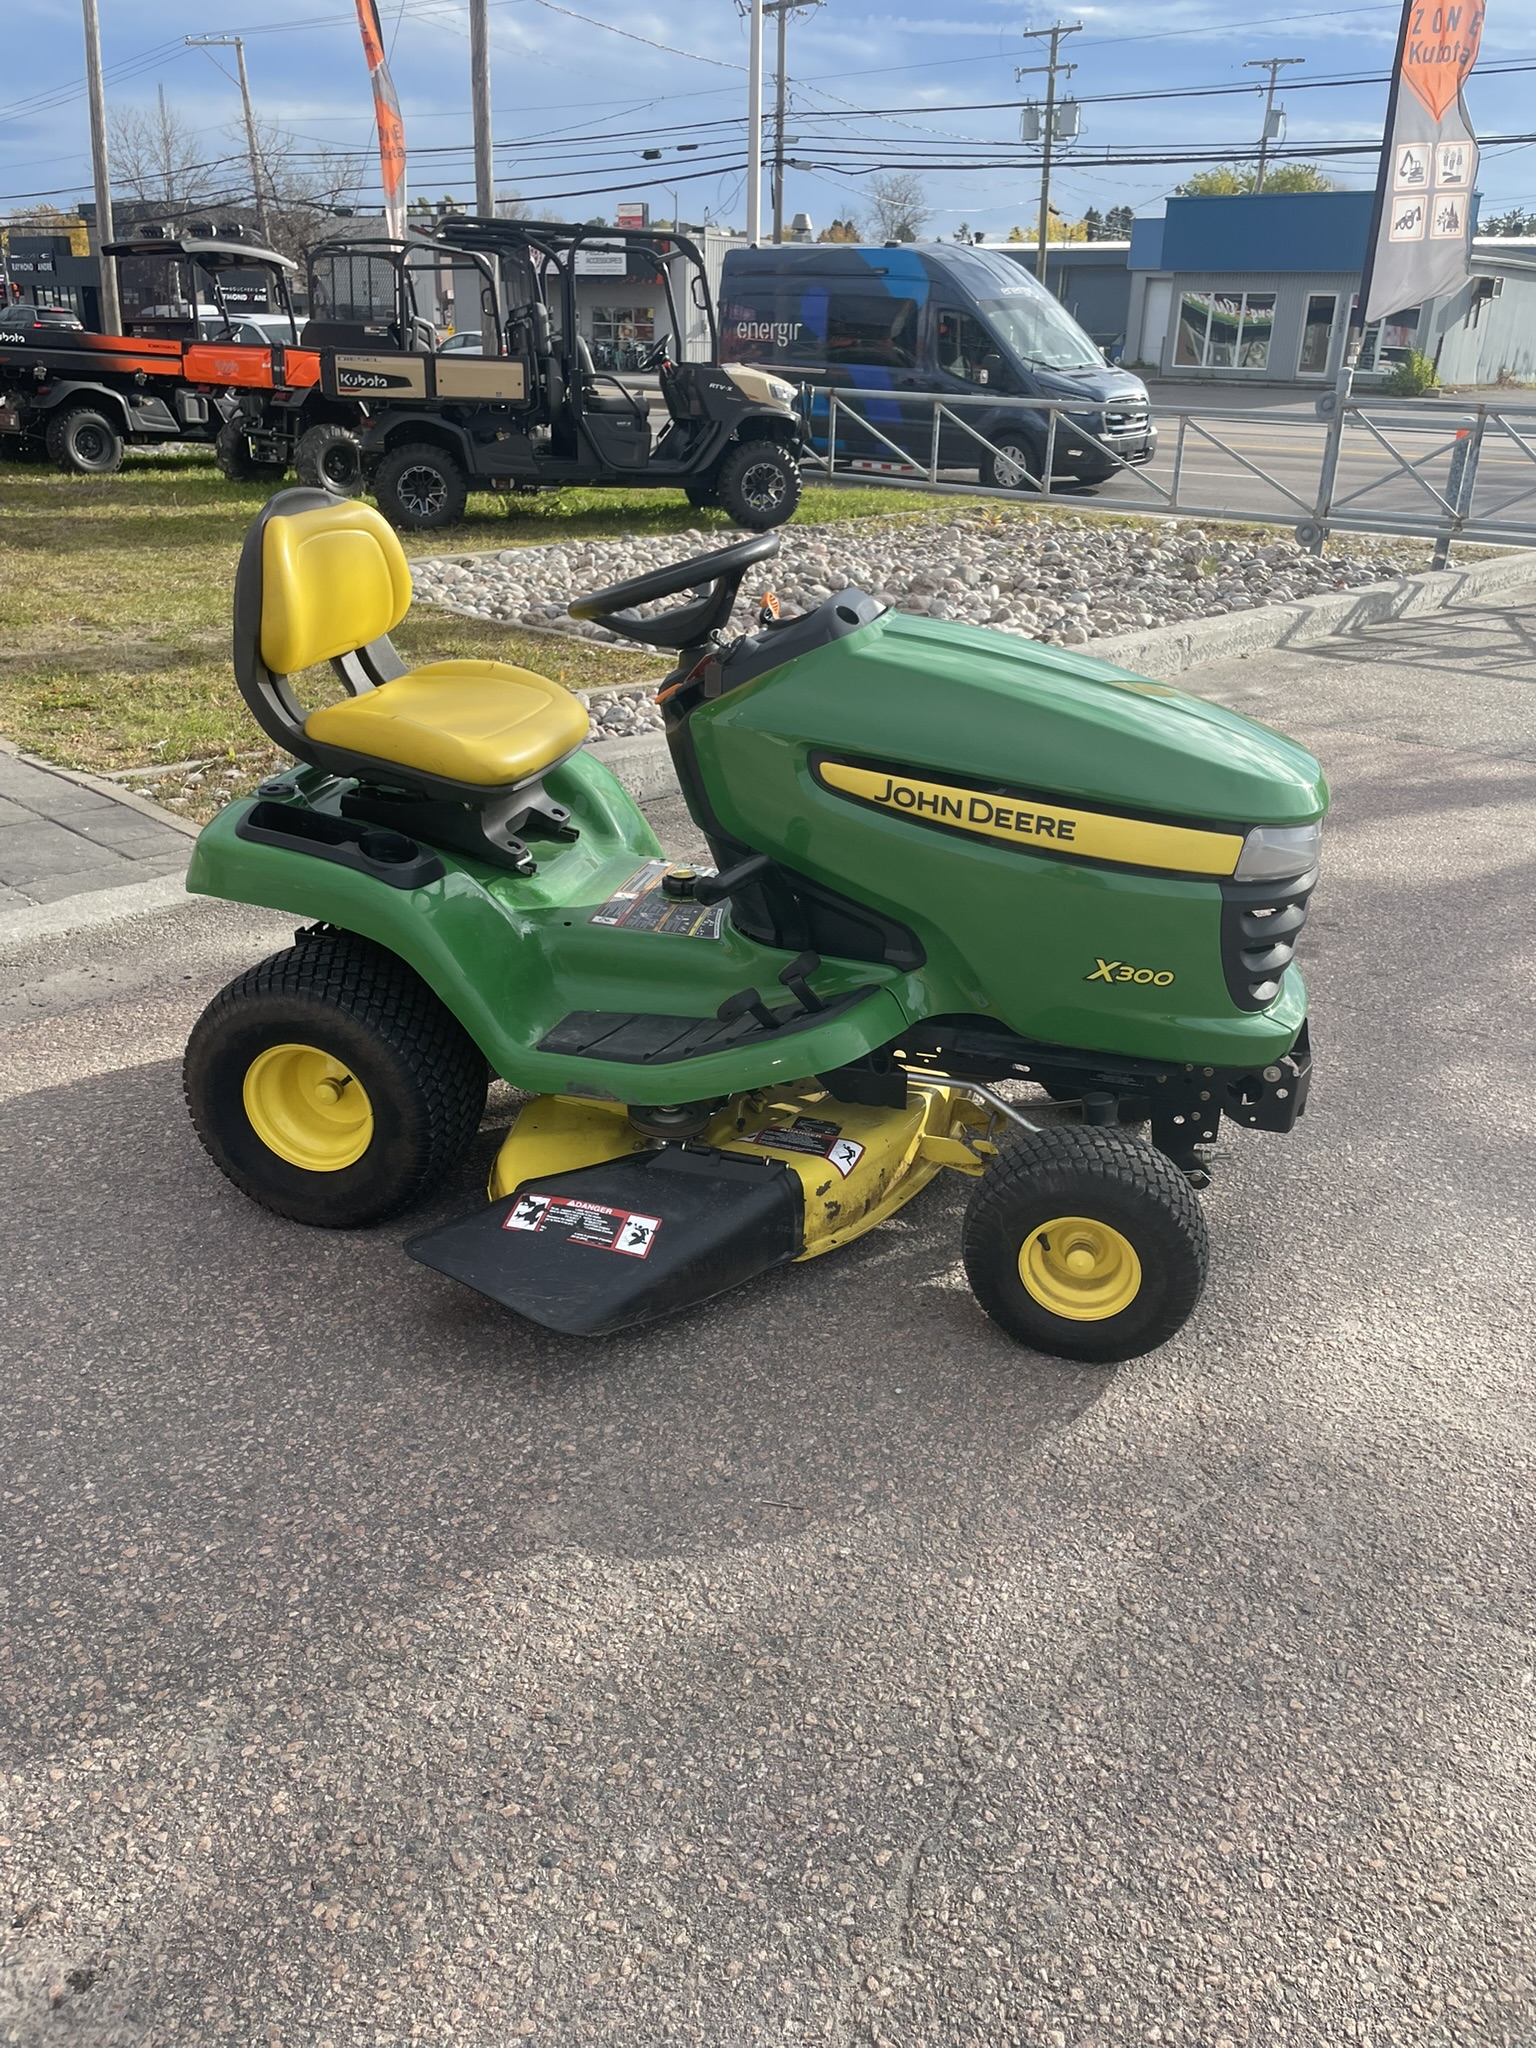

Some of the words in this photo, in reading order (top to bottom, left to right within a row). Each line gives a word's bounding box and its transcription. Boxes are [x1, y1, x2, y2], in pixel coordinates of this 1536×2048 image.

[1411, 6, 1483, 38] ZONE
[1408, 40, 1471, 65] Kubota
[340, 373, 388, 387] Kubota
[874, 779, 962, 819] JOHN
[968, 797, 1077, 841] DEERE
[1086, 958, 1174, 986] X300
[575, 1202, 613, 1215] DANGER
